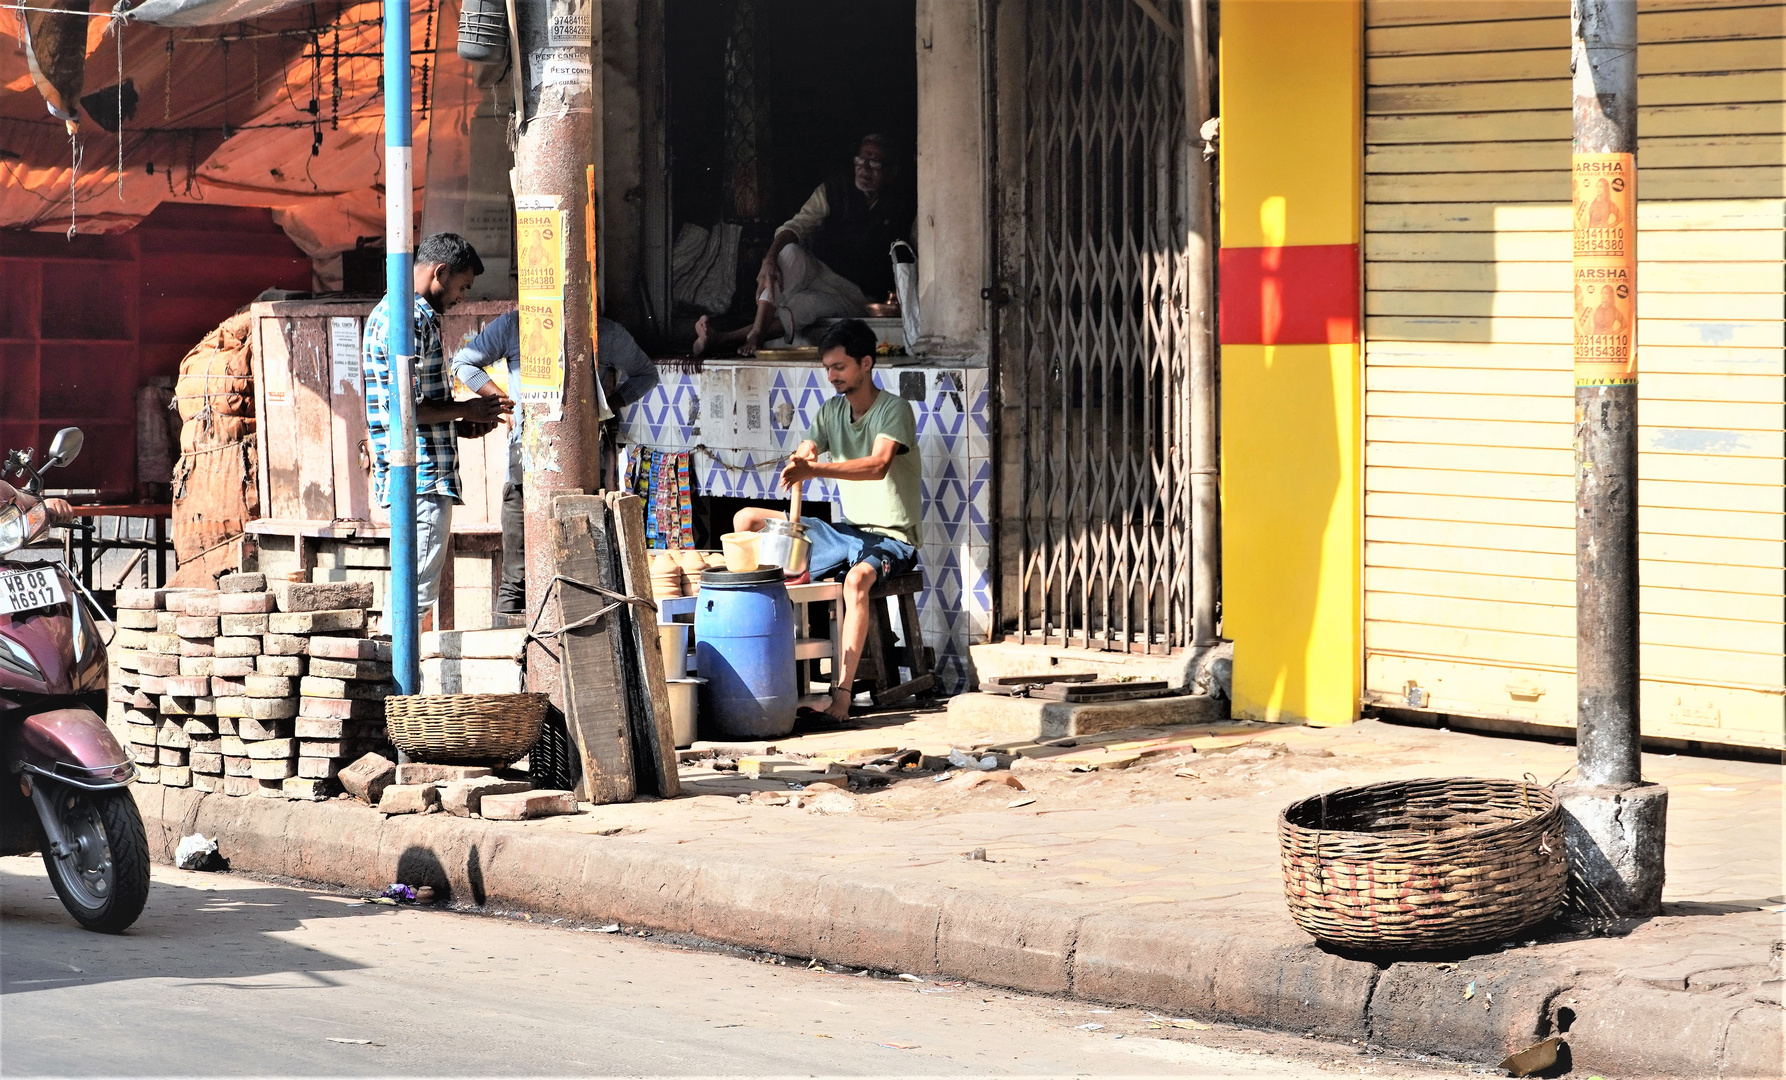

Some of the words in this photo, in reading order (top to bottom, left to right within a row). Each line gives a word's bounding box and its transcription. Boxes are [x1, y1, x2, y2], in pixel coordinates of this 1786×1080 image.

[1573, 162, 1623, 172] ARSHA
[4, 576, 25, 592] WB
[27, 571, 47, 589] 08
[9, 586, 54, 610] M6917
